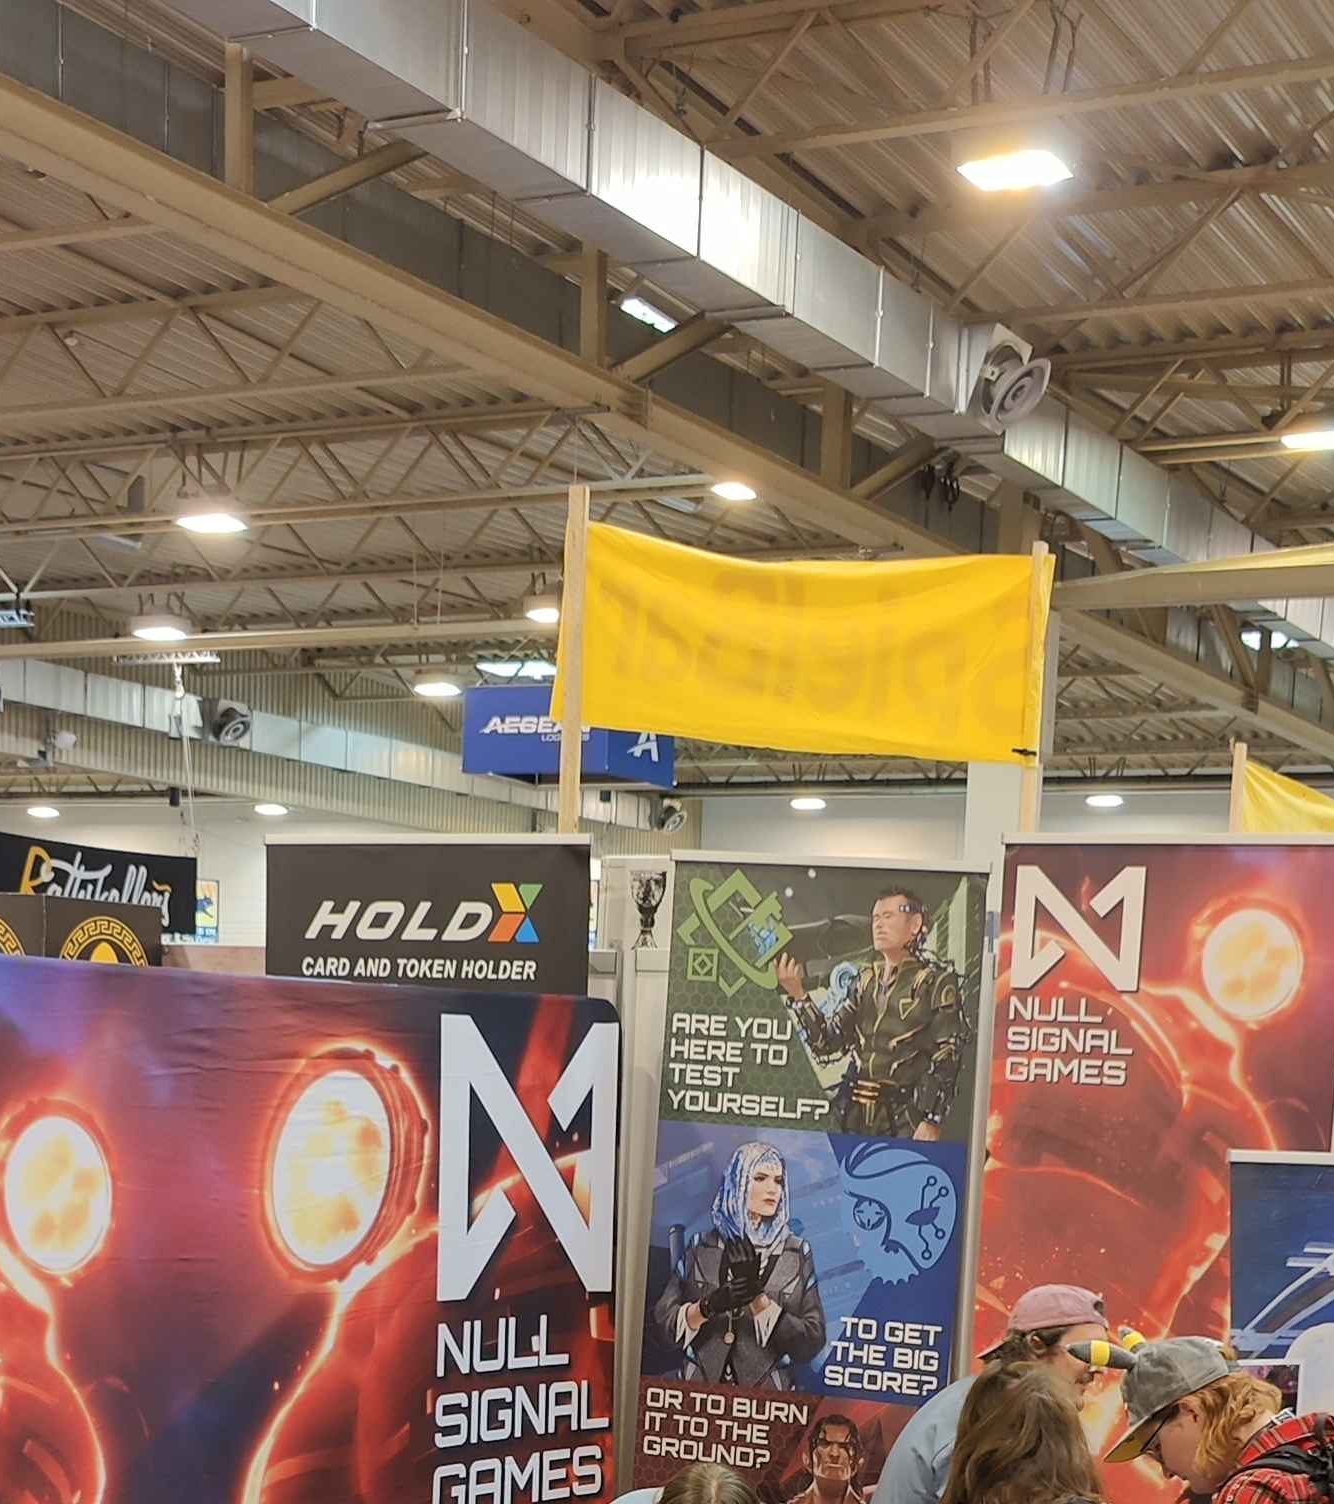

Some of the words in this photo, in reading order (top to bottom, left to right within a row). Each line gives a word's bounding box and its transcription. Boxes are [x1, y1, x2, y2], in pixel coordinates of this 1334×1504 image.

[301, 956, 351, 977] CARD
[353, 957, 391, 978] AND
[396, 958, 457, 979] TOKEN
[461, 959, 537, 980] HOLDER
[1007, 995, 1103, 1024] NULL
[671, 1013, 727, 1037] ARE
[735, 1016, 792, 1041] YOU
[1006, 1025, 1133, 1056] SIGNAL
[670, 1037, 743, 1063] HERE
[751, 1043, 788, 1066] TO
[668, 1062, 740, 1088] TEST
[1005, 1056, 1127, 1086] GAMES
[667, 1089, 829, 1121] YOURSELF?
[436, 1314, 569, 1377] NULL
[841, 1316, 877, 1340] TO
[884, 1320, 942, 1346] GET
[830, 1340, 886, 1366] THE
[893, 1347, 940, 1372] BIG
[824, 1365, 939, 1397] SCORE?
[433, 1379, 610, 1449] SIGNAL
[646, 1387, 683, 1409] OR
[689, 1392, 727, 1416] TO
[731, 1396, 809, 1425] BURN
[644, 1411, 667, 1432] IT
[673, 1415, 709, 1437] TO
[715, 1419, 770, 1445] THE
[643, 1435, 771, 1469] GROUND?
